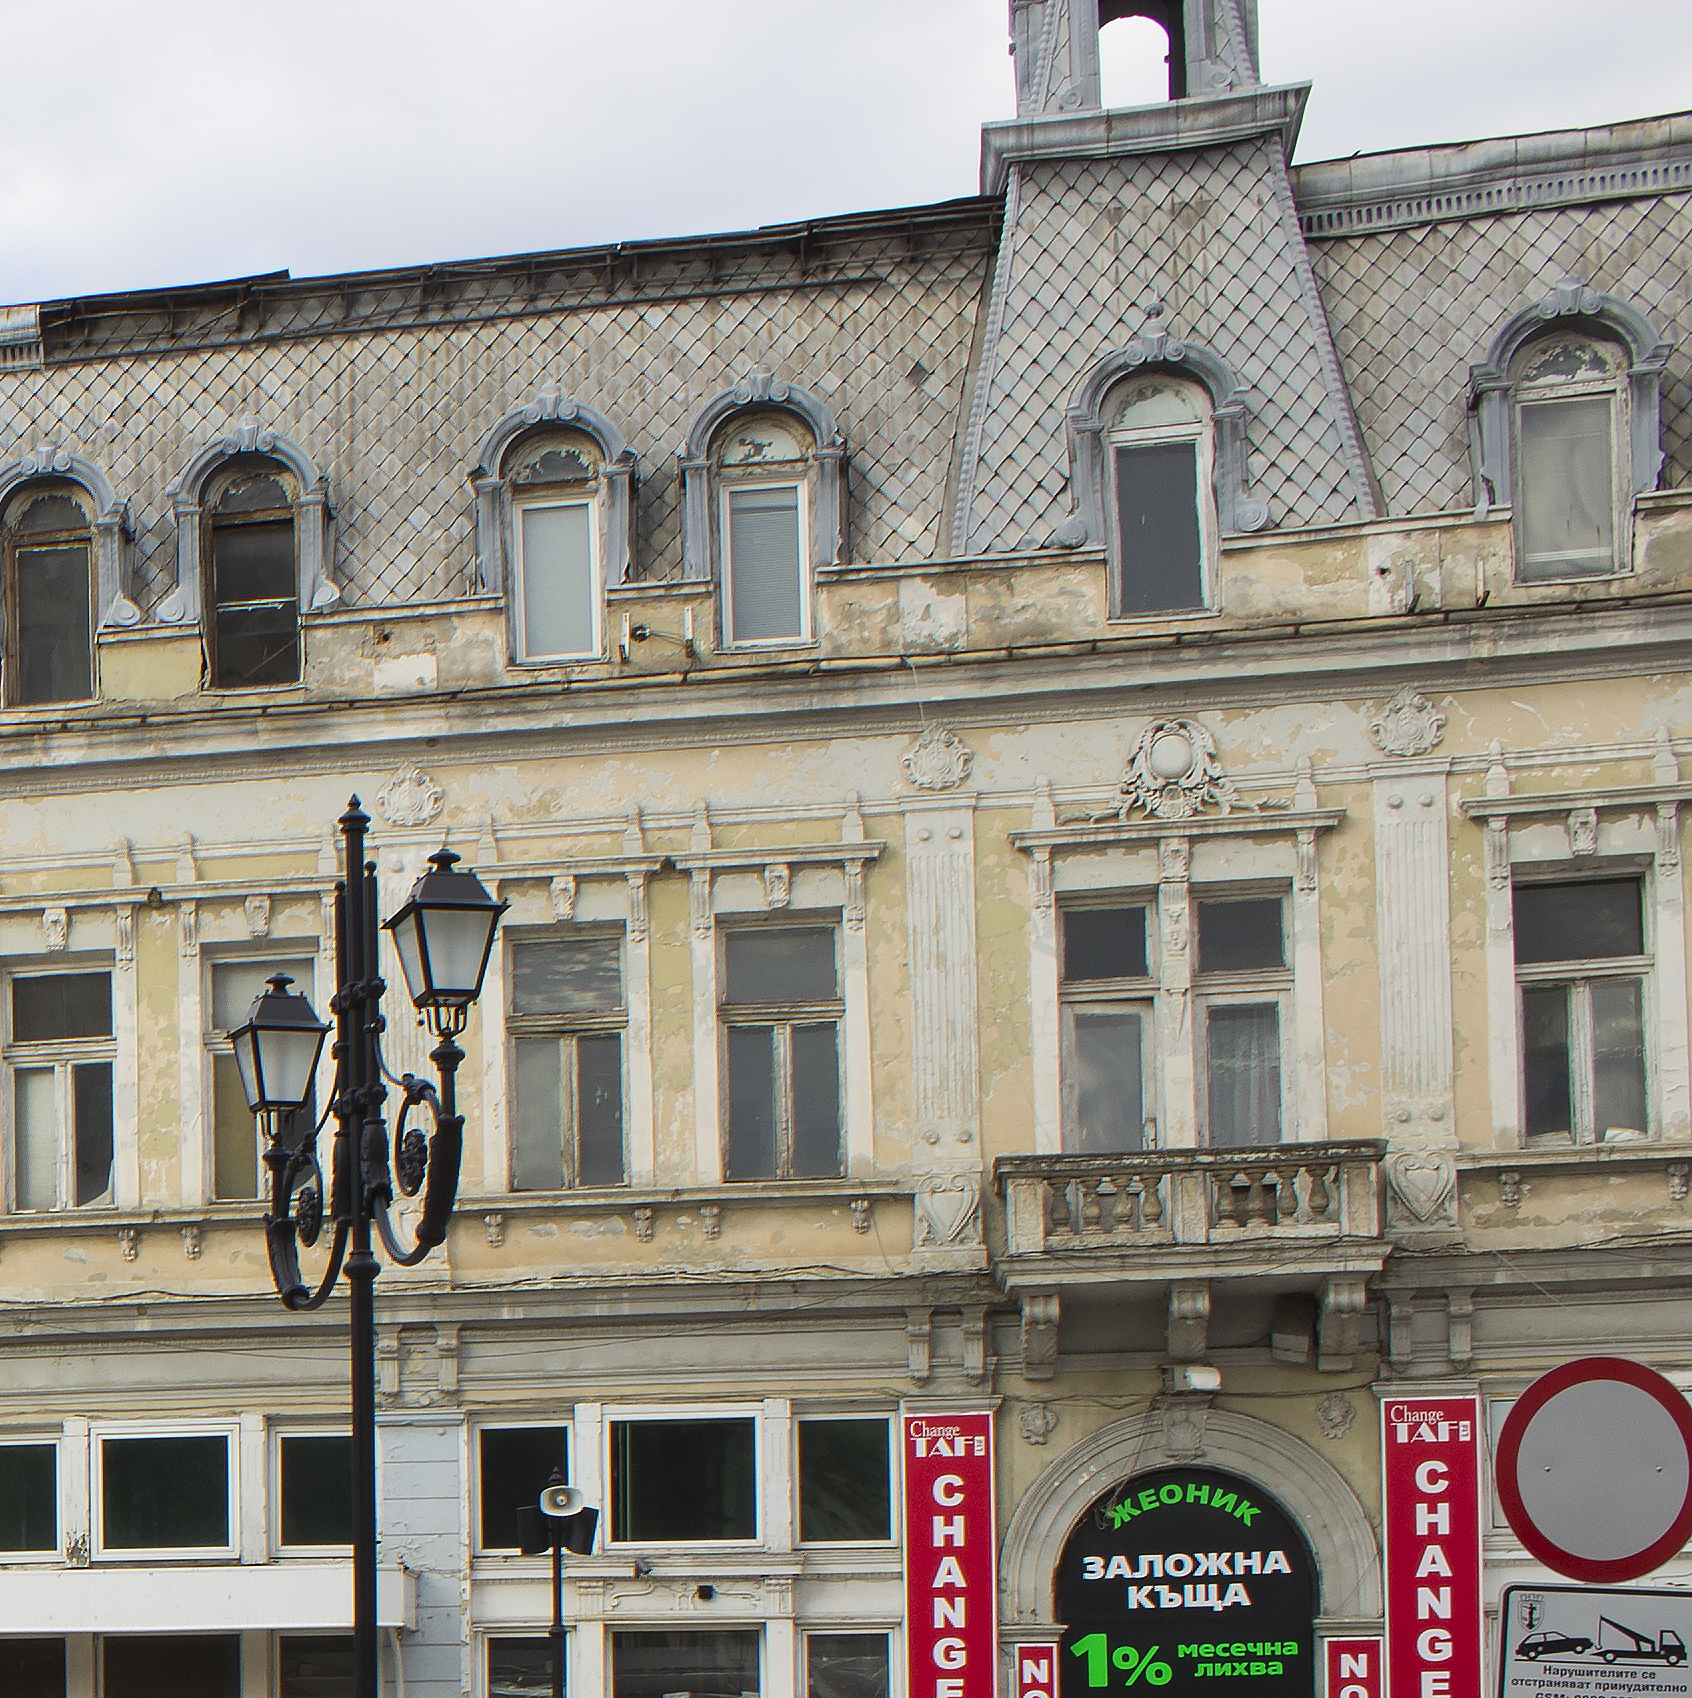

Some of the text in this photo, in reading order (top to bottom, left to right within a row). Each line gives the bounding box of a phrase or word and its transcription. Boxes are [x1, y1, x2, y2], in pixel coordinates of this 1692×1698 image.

[1390, 1405, 1444, 1425] Change
[910, 1420, 961, 1440] Change
[1106, 1484, 1261, 1529] ЖЕОНИК
[1082, 1550, 1293, 1580] ЗАЛОЖНА
[1127, 1582, 1252, 1612] КЪЩА
[1177, 1641, 1299, 1658] месечна
[1070, 1633, 1173, 1688] 1%
[1194, 1661, 1284, 1677] лихва
[1542, 1665, 1656, 1681] Нарушителите се
[1511, 1678, 1687, 1694] отстраняват принудително
